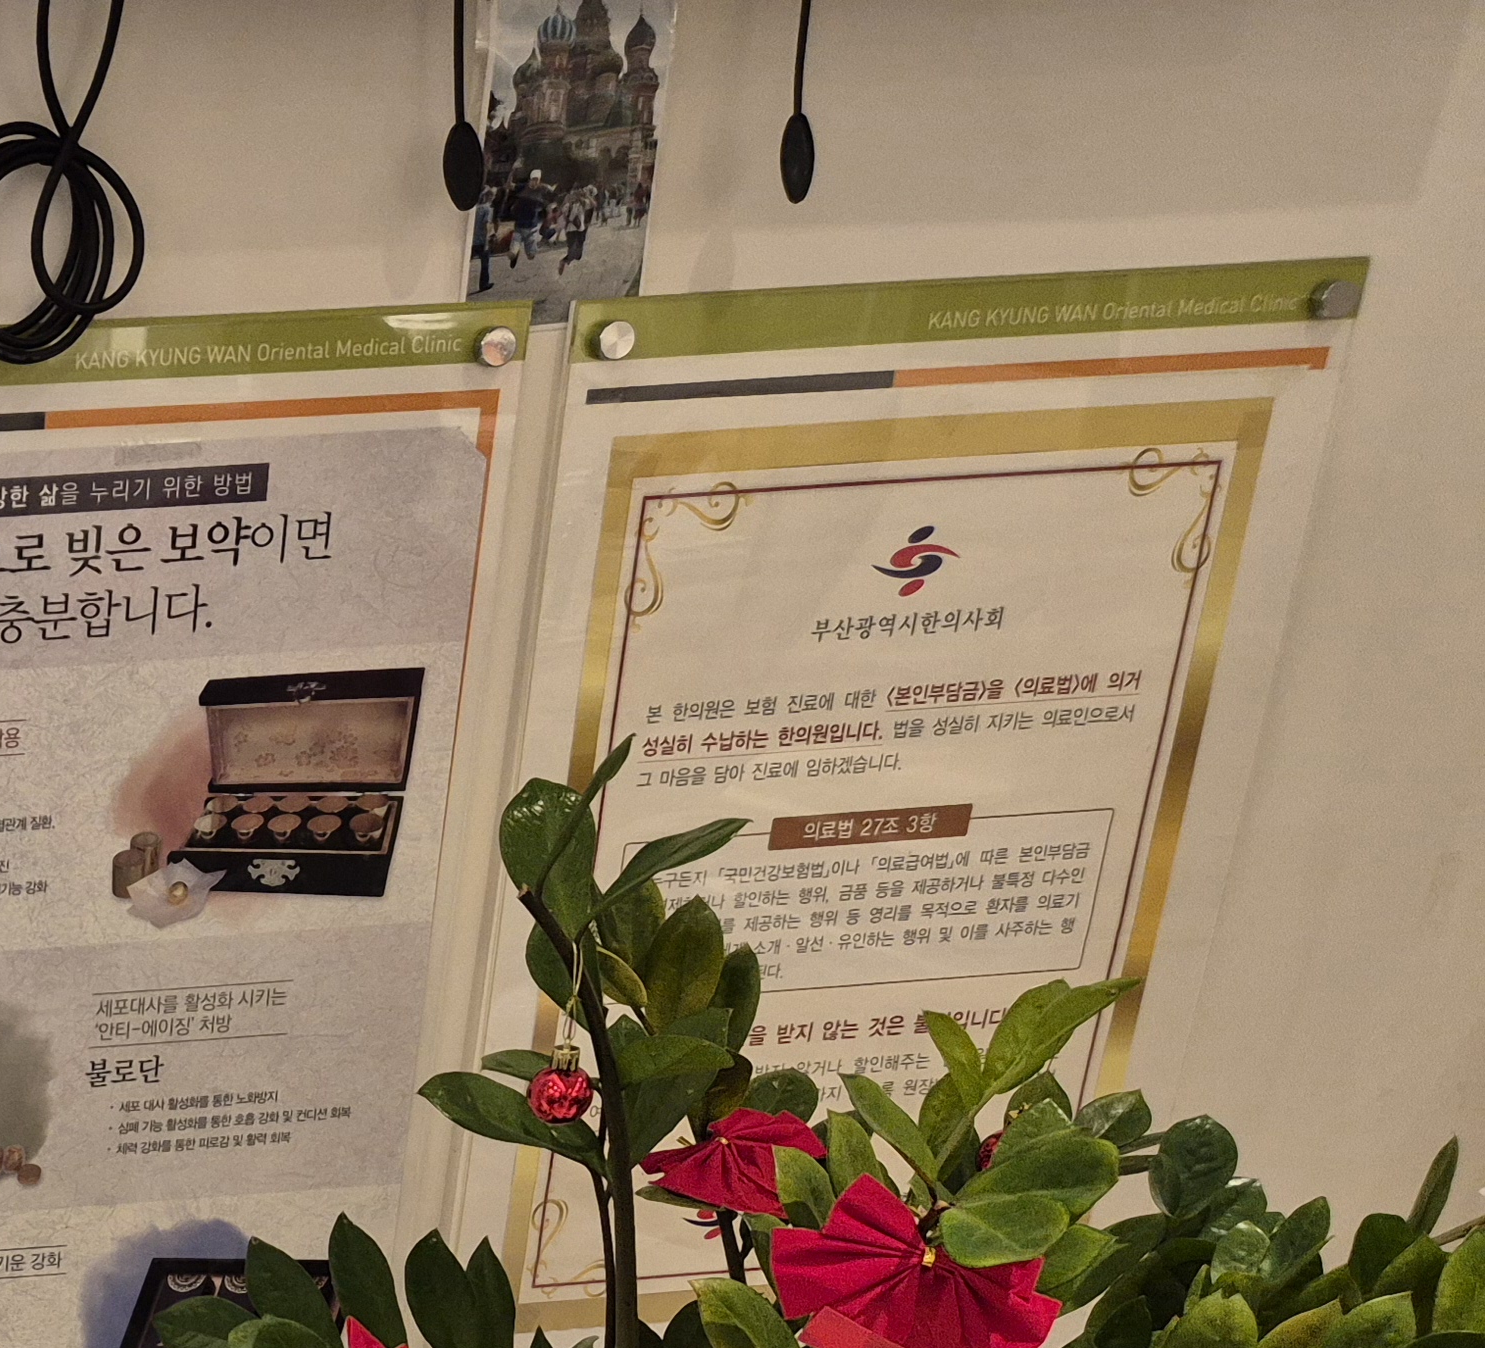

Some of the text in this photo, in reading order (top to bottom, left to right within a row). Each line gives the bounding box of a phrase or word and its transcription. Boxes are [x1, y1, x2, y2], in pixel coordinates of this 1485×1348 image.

[928, 294, 1298, 330] KANG KYUNG WAN Oriental Medical Clinic
[75, 335, 462, 370] KANG KYUNG WAN Oriental Medical Clinic
[39, 481, 80, 508] 삶을
[89, 478, 151, 506] 누리기
[162, 474, 203, 500] 위한
[214, 471, 253, 497] 방법
[65, 523, 152, 577] 빚은
[160, 511, 333, 567] 보약이면
[812, 605, 1006, 643] 부산광역시한의사회
[646, 704, 662, 724] 본
[672, 699, 735, 722] 한의원은
[743, 696, 778, 716] 보험
[787, 692, 835, 714] 진료에
[844, 689, 877, 709] 대한
[1107, 669, 1142, 691] 의거
[642, 704, 1136, 757] 성실히 수납하는 한의원입니다. 법을 성실히 지키는 의료인으로서
[636, 752, 902, 788] 그 마음을 담아 진료에 임하겠습니다.
[803, 812, 937, 840] 의료법 27조 3항
[980, 847, 1009, 866] 따른
[1018, 841, 1091, 863] 본인부담금
[734, 890, 791, 909] 할인하는
[798, 886, 829, 905] 행위,
[839, 883, 868, 902] 금품
[875, 880, 904, 899] 등을
[911, 874, 984, 895] 제공하거나
[991, 871, 1035, 889] 불특정
[1042, 867, 1086, 885] 다수인
[744, 914, 801, 932] 제공하는
[810, 910, 838, 928] 행위
[846, 909, 860, 925] 등
[869, 904, 912, 924] 영리를
[920, 900, 977, 919] 목적으로
[985, 896, 1029, 915] 환자를
[1036, 893, 1080, 910] 의료기
[796, 936, 823, 953] 알선
[837, 930, 894, 949] 유인하는
[903, 927, 931, 946] 행위
[939, 926, 952, 943] 및
[960, 924, 989, 941] 이를
[995, 919, 1053, 937] 사주하는
[1061, 917, 1076, 934] 행
[96, 986, 288, 1018] 세포대사를 활성화 시키는
[199, 1014, 232, 1034] 처방
[777, 1022, 813, 1044] 받지
[822, 1019, 859, 1041] 않는
[868, 1015, 906, 1037] 것은
[85, 1055, 165, 1088] 불로단
[854, 1053, 931, 1075] 할인해주는
[30, 1251, 62, 1270] 강화
